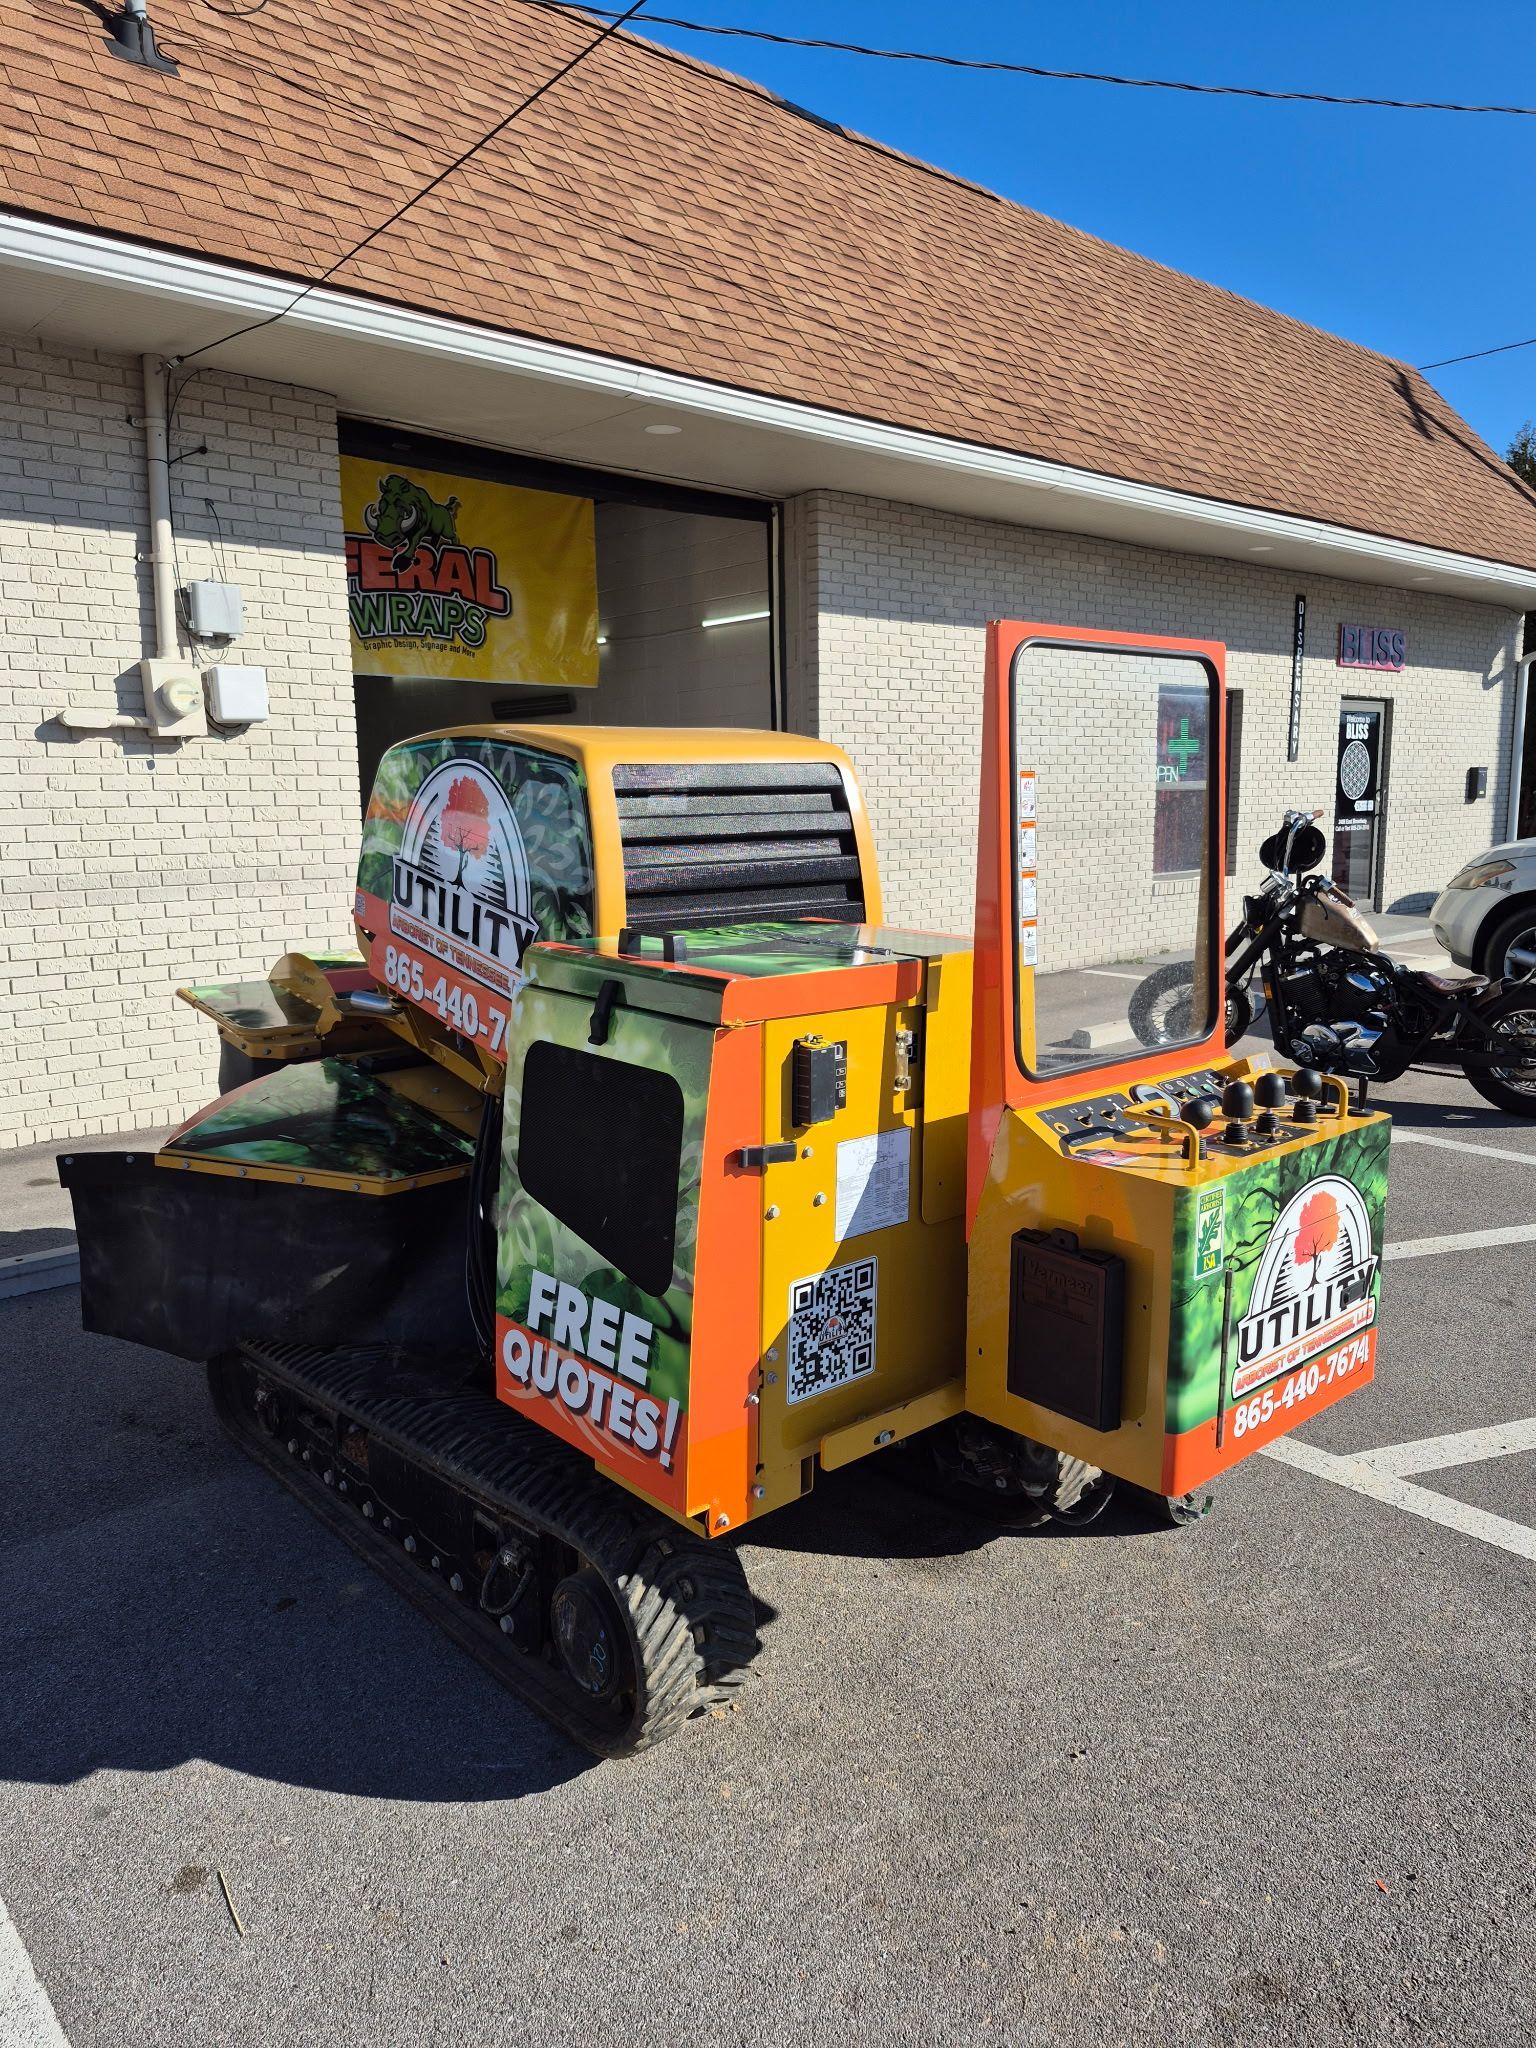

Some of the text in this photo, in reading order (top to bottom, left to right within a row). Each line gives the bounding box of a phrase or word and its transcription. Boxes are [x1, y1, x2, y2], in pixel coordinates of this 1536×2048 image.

[350, 596, 484, 644] WRAPS
[364, 639, 476, 658] Graphic Design, Signage and More
[1342, 626, 1405, 667] BLISS
[1292, 601, 1304, 753] DISPENSARY
[1346, 714, 1366, 723] Welcome
[1346, 723, 1369, 740] BLISS
[1156, 766, 1179, 782] PEN
[392, 914, 434, 949] ARBORIST
[436, 937, 448, 955] OF
[395, 863, 535, 970] UTILITY
[385, 945, 511, 1054] 865-440-7
[1200, 1199, 1222, 1211] ARBORIST
[1203, 1252, 1216, 1272] ISA
[527, 1269, 653, 1386] FREE
[1240, 1264, 1374, 1363] UTILITY
[1235, 1355, 1286, 1392] ARBORIST
[1286, 1349, 1301, 1364] OF
[1355, 1307, 1373, 1326] LLC
[503, 1329, 680, 1468] QUOTES!
[1234, 1335, 1369, 1438] 865-440-7674
